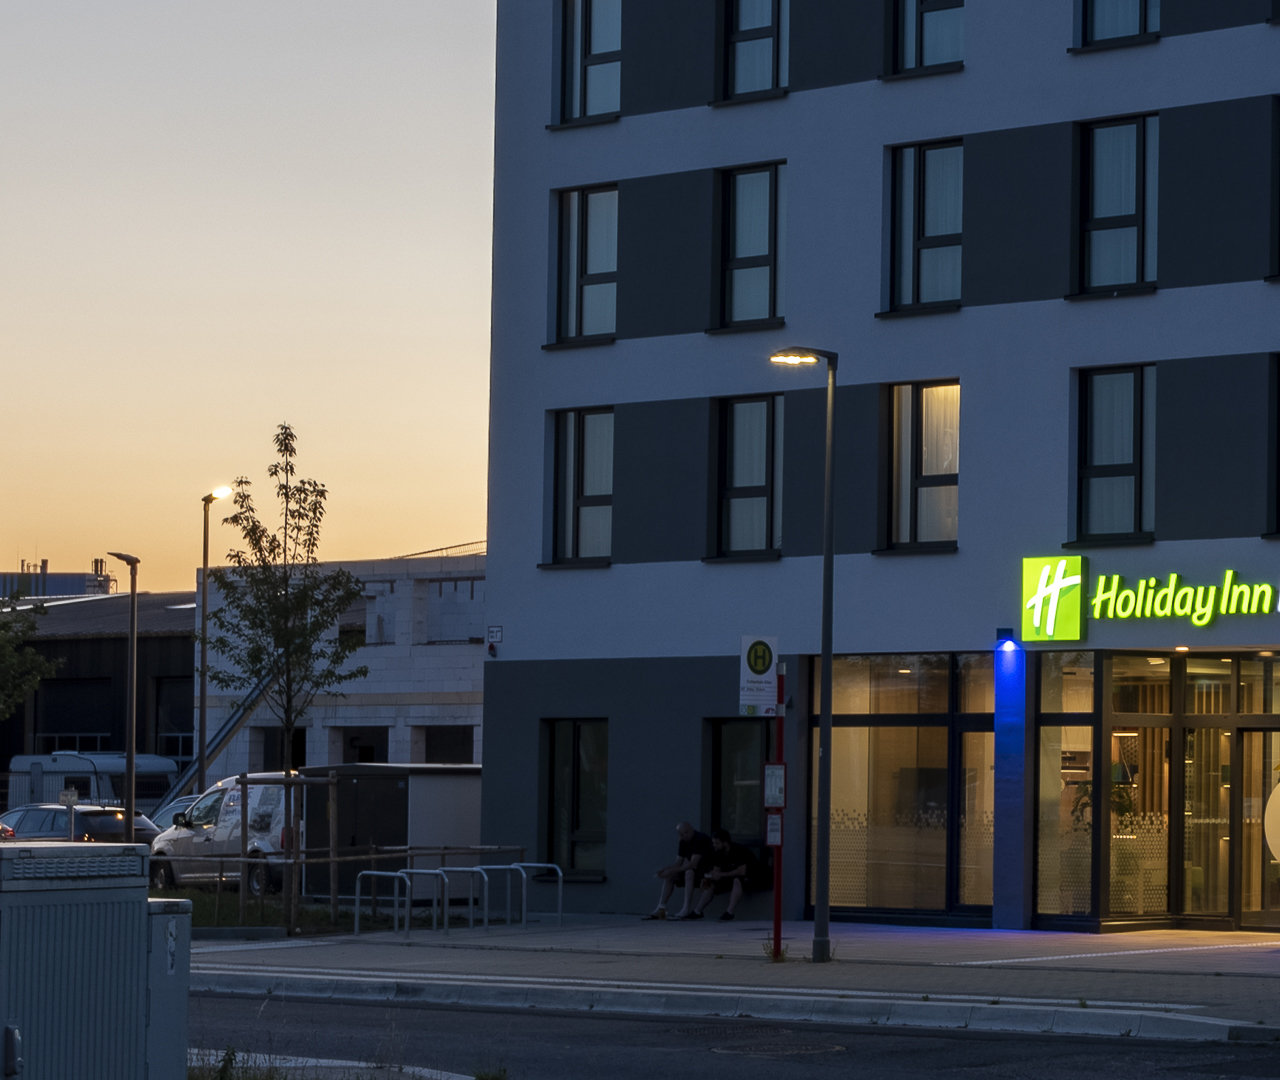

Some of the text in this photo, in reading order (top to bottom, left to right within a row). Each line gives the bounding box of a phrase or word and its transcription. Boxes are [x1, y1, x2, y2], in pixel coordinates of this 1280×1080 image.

[1091, 572, 1217, 627] Holiday
[1219, 569, 1273, 615] Inn
[753, 647, 767, 668] H
